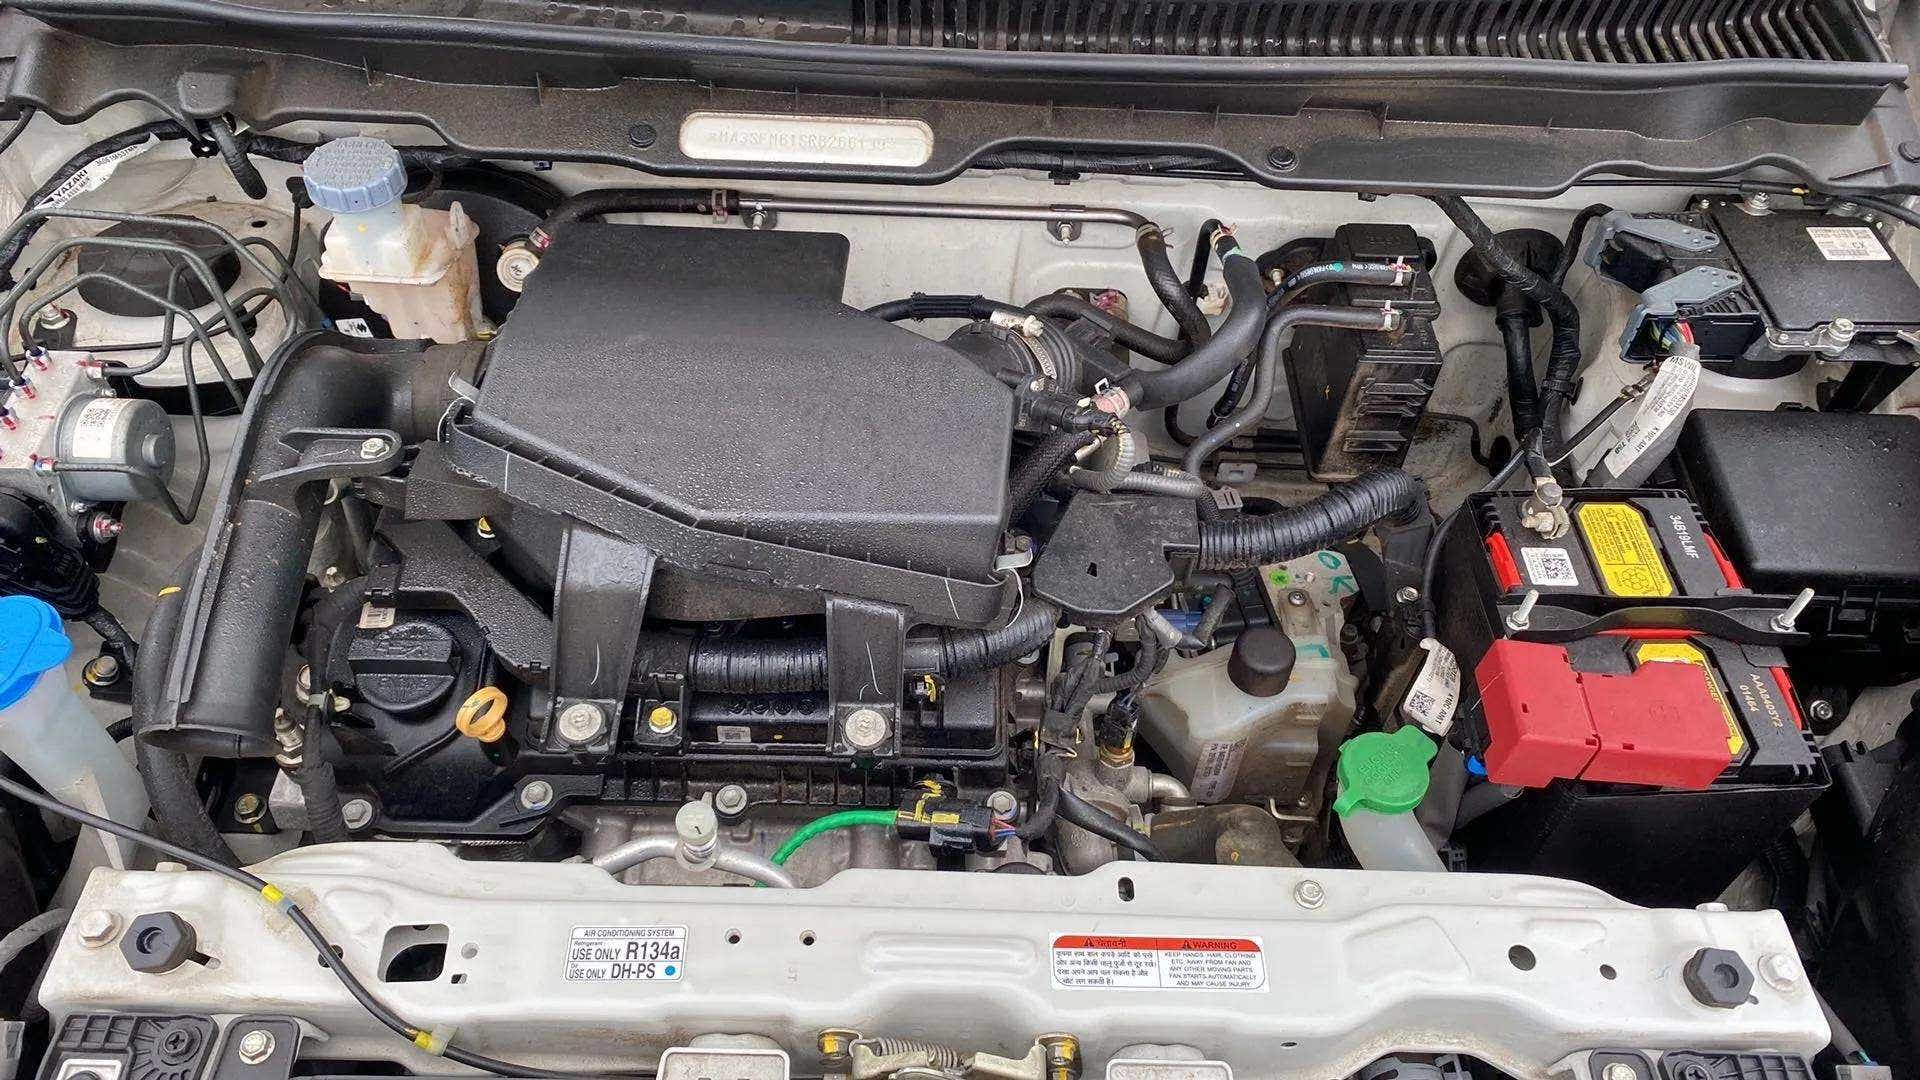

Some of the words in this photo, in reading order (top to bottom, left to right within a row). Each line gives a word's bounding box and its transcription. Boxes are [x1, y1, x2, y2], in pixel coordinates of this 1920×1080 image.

[54, 169, 88, 197] YAZAKI
[597, 929, 646, 937] CONDITIONING
[647, 929, 675, 937] SYSTEM
[1096, 938, 1126, 948] चेतावनी
[1192, 941, 1237, 950] WARNING
[572, 948, 592, 960] USE
[594, 948, 621, 960] ONLY
[626, 941, 680, 960] R134a
[569, 968, 584, 979] USE
[586, 968, 607, 979] ONLY
[611, 963, 656, 979] DH-PS
